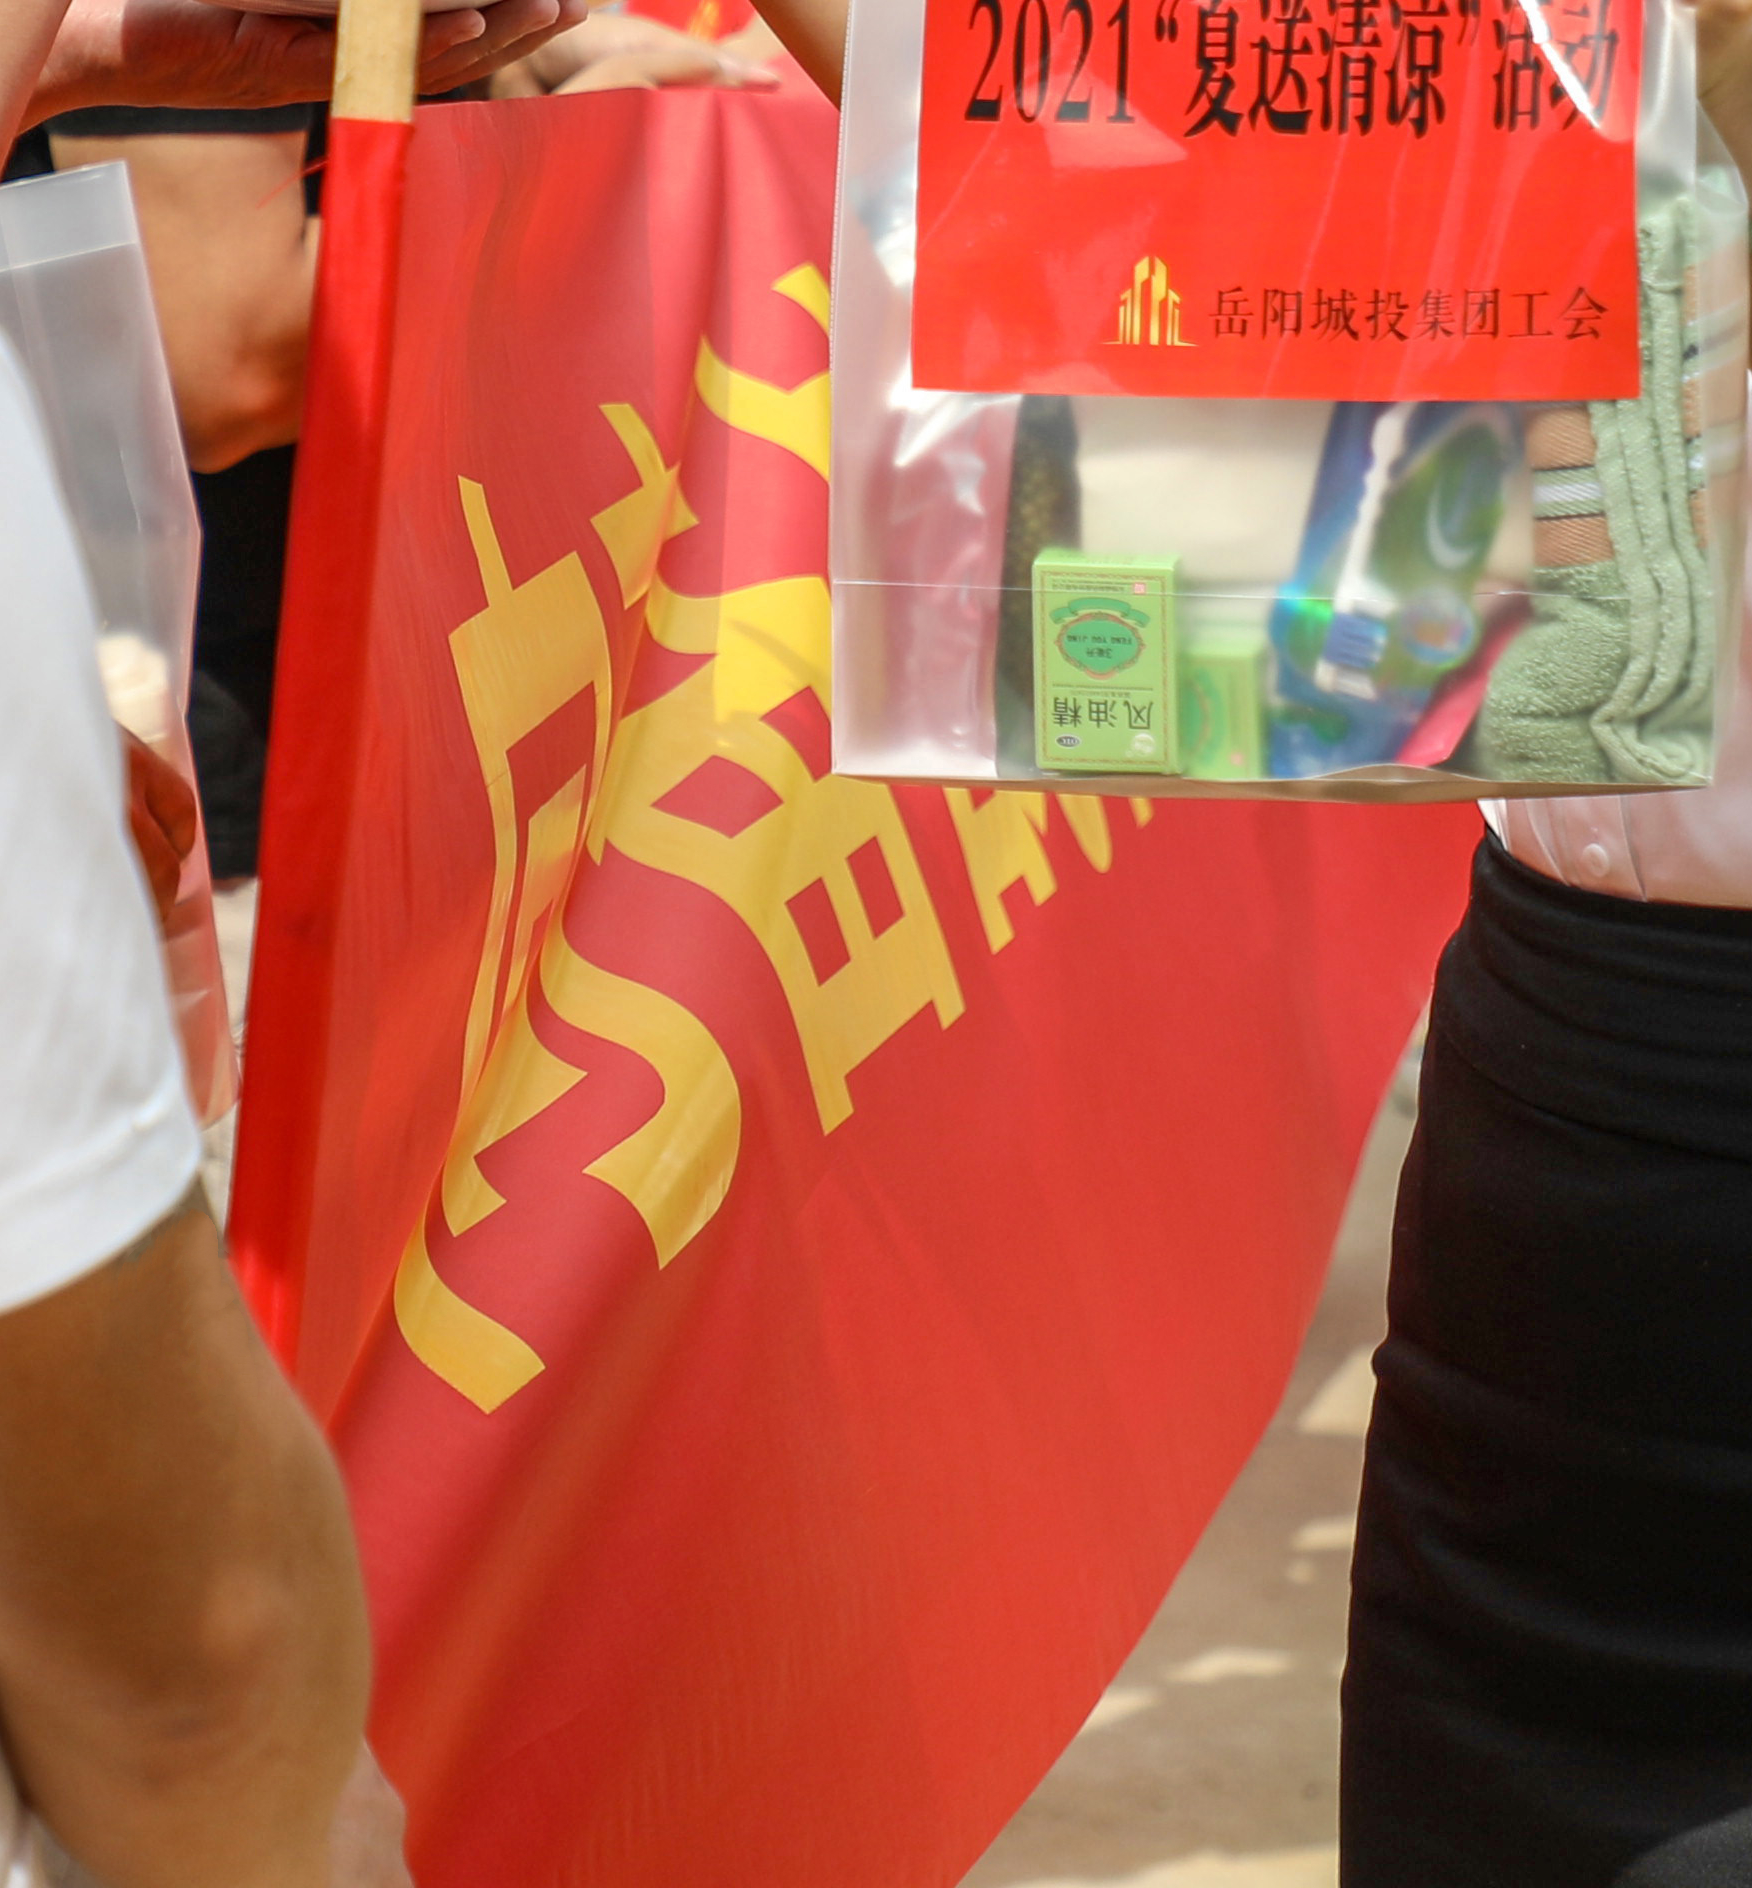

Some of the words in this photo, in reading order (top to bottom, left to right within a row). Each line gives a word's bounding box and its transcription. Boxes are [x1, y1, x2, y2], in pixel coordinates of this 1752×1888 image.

[1208, 285, 1609, 342] 岳阳城投集团工会
[1052, 697, 1153, 729] 风油精
